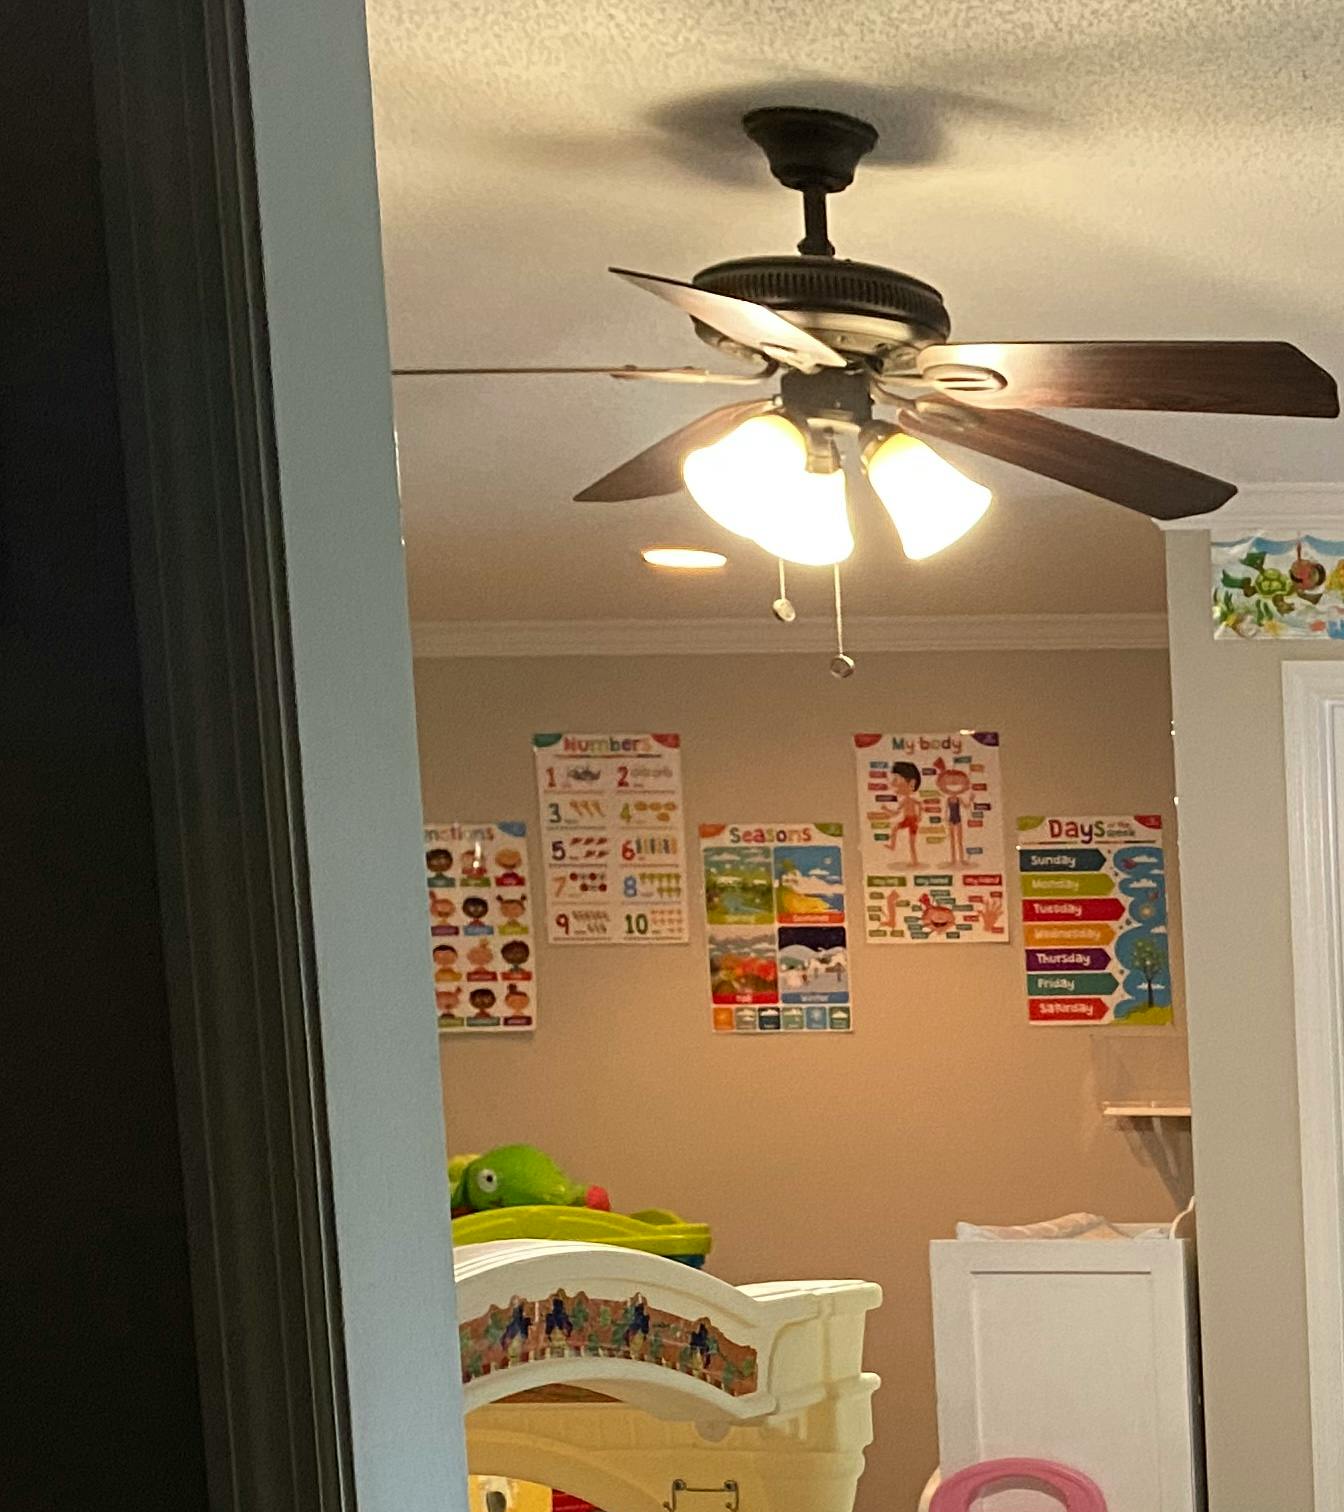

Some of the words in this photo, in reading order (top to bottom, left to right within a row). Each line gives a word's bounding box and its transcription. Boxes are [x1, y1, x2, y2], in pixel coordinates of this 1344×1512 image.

[563, 736, 651, 752] Numbers
[892, 737, 915, 755] My
[919, 737, 963, 754] body
[546, 767, 556, 788] 1
[617, 766, 629, 787] 2
[549, 803, 562, 823] 3
[620, 802, 632, 823] 4
[729, 827, 812, 844] Seasons
[1048, 820, 1106, 844] Days
[552, 841, 565, 861] 5
[622, 840, 635, 861] 6
[1031, 855, 1076, 868] Sunday
[554, 877, 566, 898] 7
[624, 876, 637, 897] 8
[1032, 879, 1079, 891] Monday
[1033, 903, 1083, 916] Tuesday
[556, 913, 569, 935] 9
[625, 913, 648, 935] 10
[1034, 929, 1101, 941] Wednesday
[1036, 953, 1091, 966] Thursday
[1038, 978, 1075, 990] Friday
[1039, 1003, 1094, 1015] Saturday
